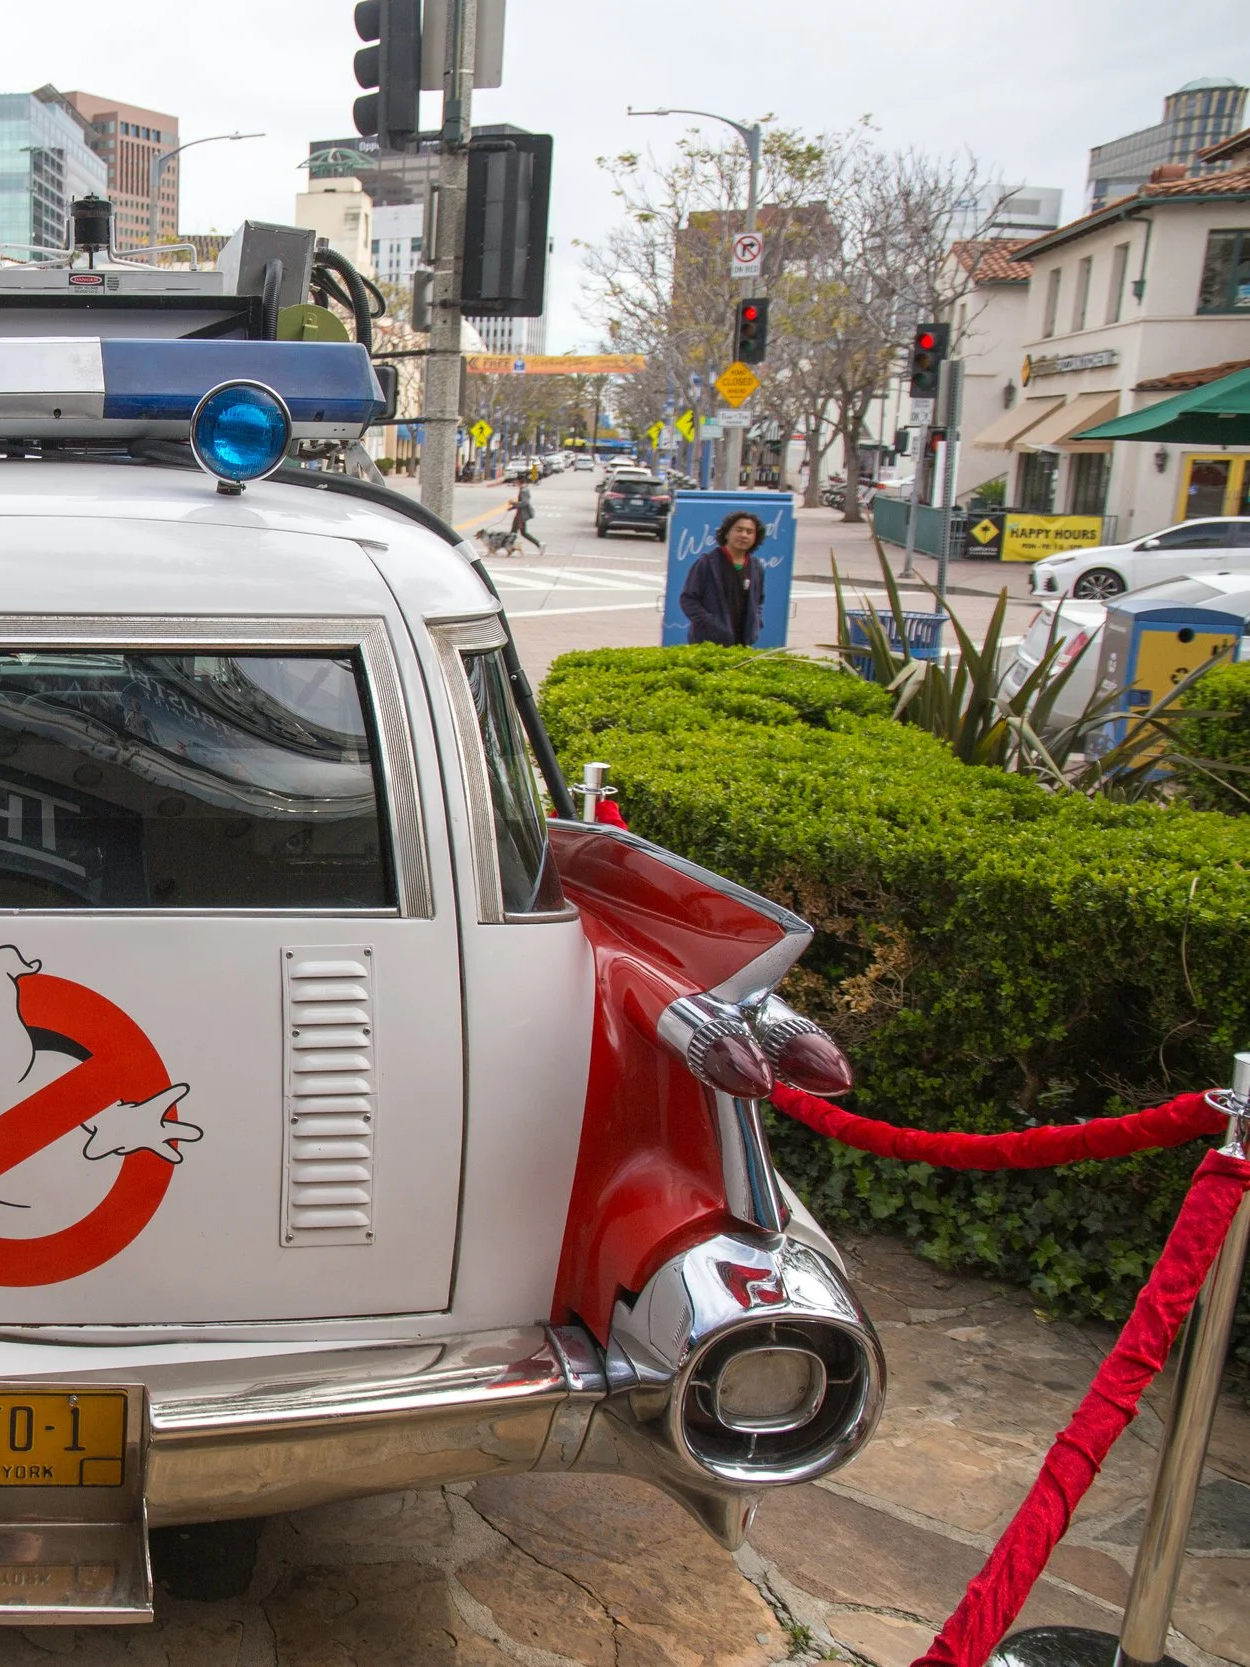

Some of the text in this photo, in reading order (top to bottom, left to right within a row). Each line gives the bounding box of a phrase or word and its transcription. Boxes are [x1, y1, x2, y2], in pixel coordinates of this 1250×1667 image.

[744, 264, 758, 273] RED
[722, 376, 754, 386] CLOSED
[1010, 527, 1097, 540] HAPPY HOURS
[3, 1464, 55, 1479] YORK
